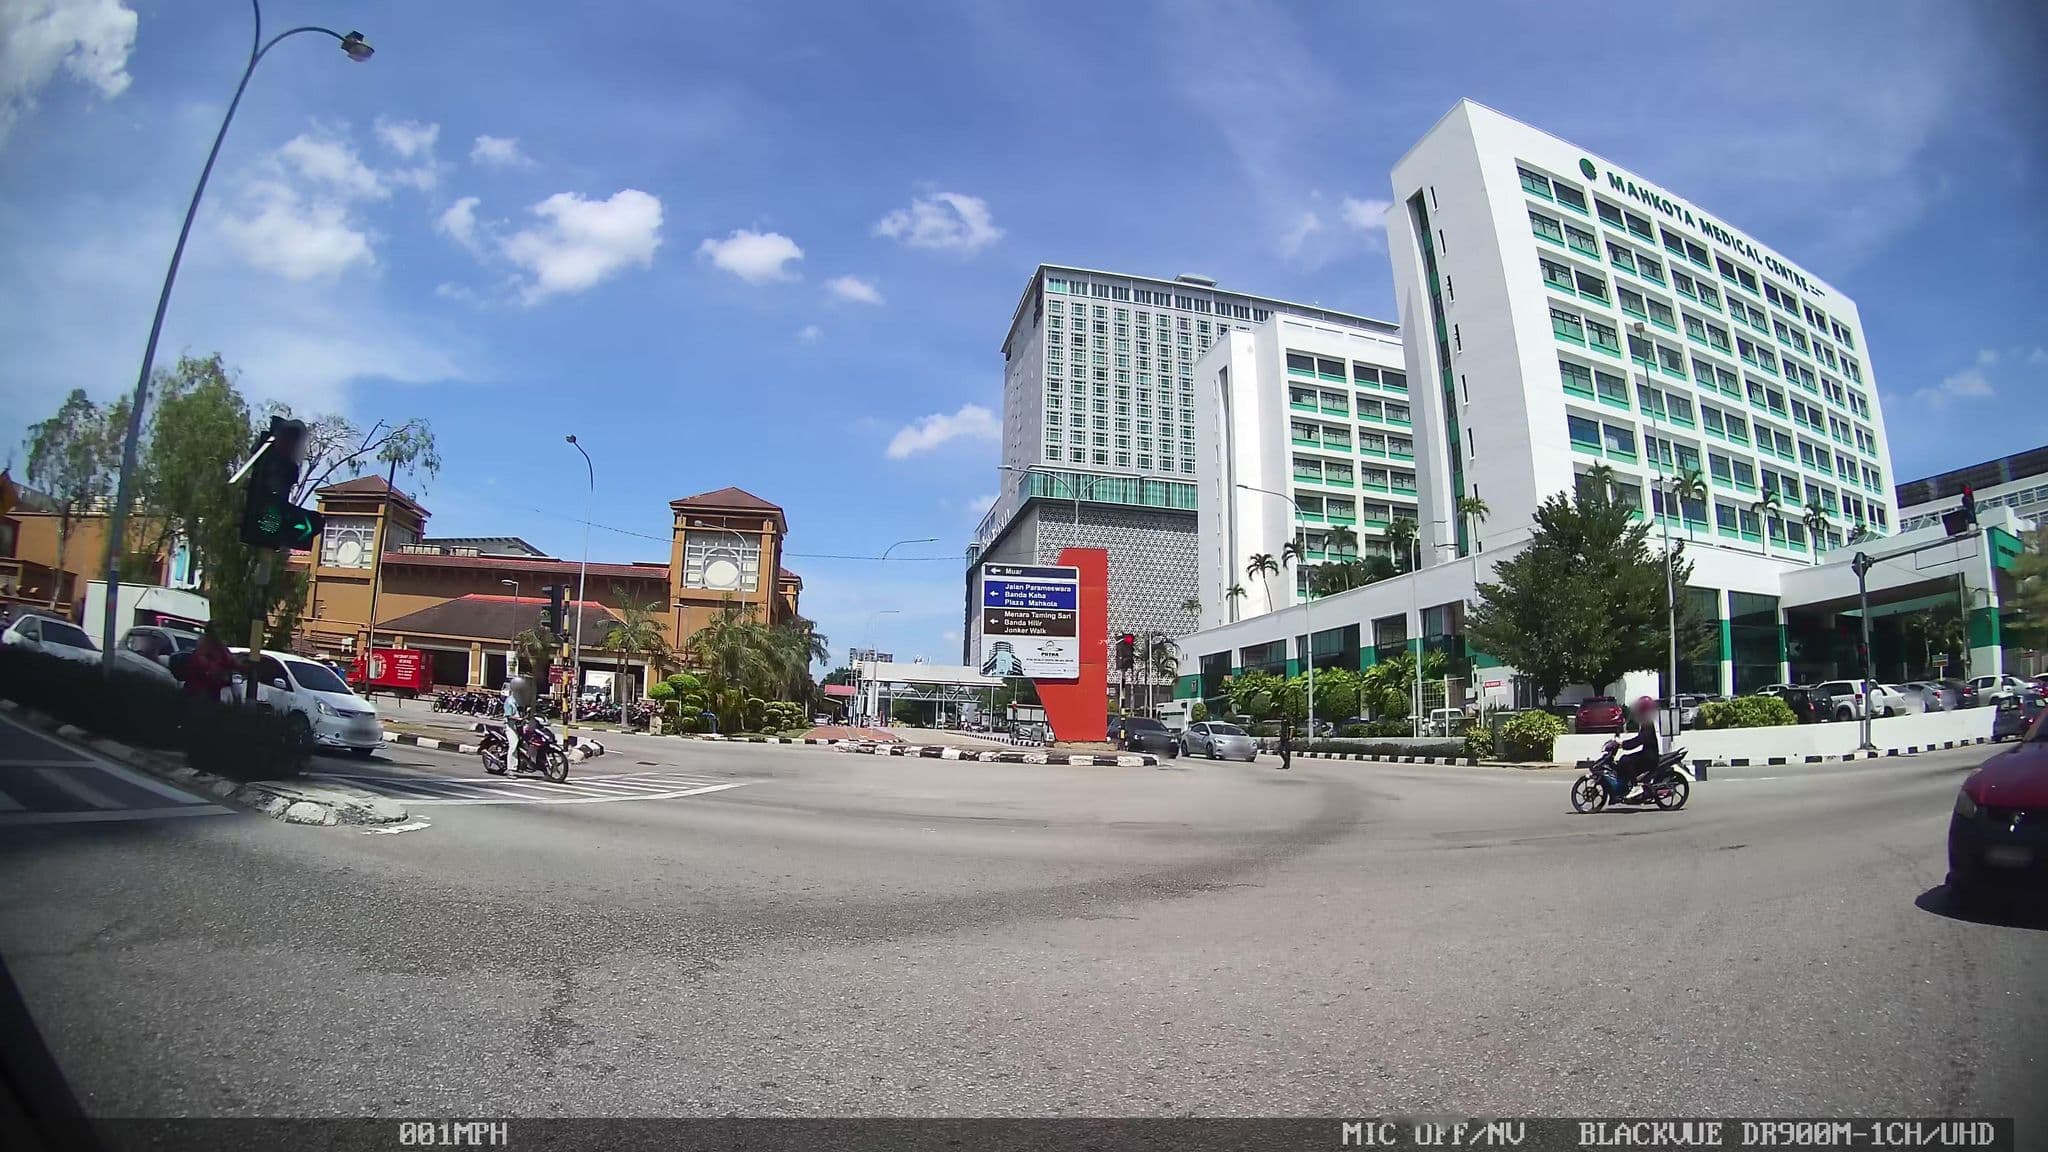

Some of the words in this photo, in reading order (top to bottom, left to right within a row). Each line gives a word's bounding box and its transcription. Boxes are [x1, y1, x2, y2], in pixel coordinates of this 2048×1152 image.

[1607, 171, 1696, 229] MAHKOTA
[1698, 217, 1763, 265] MEDICAL
[1764, 255, 1809, 292] CENTRE
[1025, 584, 1072, 592] Parameswara
[1028, 599, 1058, 607] Mahkota
[1031, 611, 1056, 620] Taming
